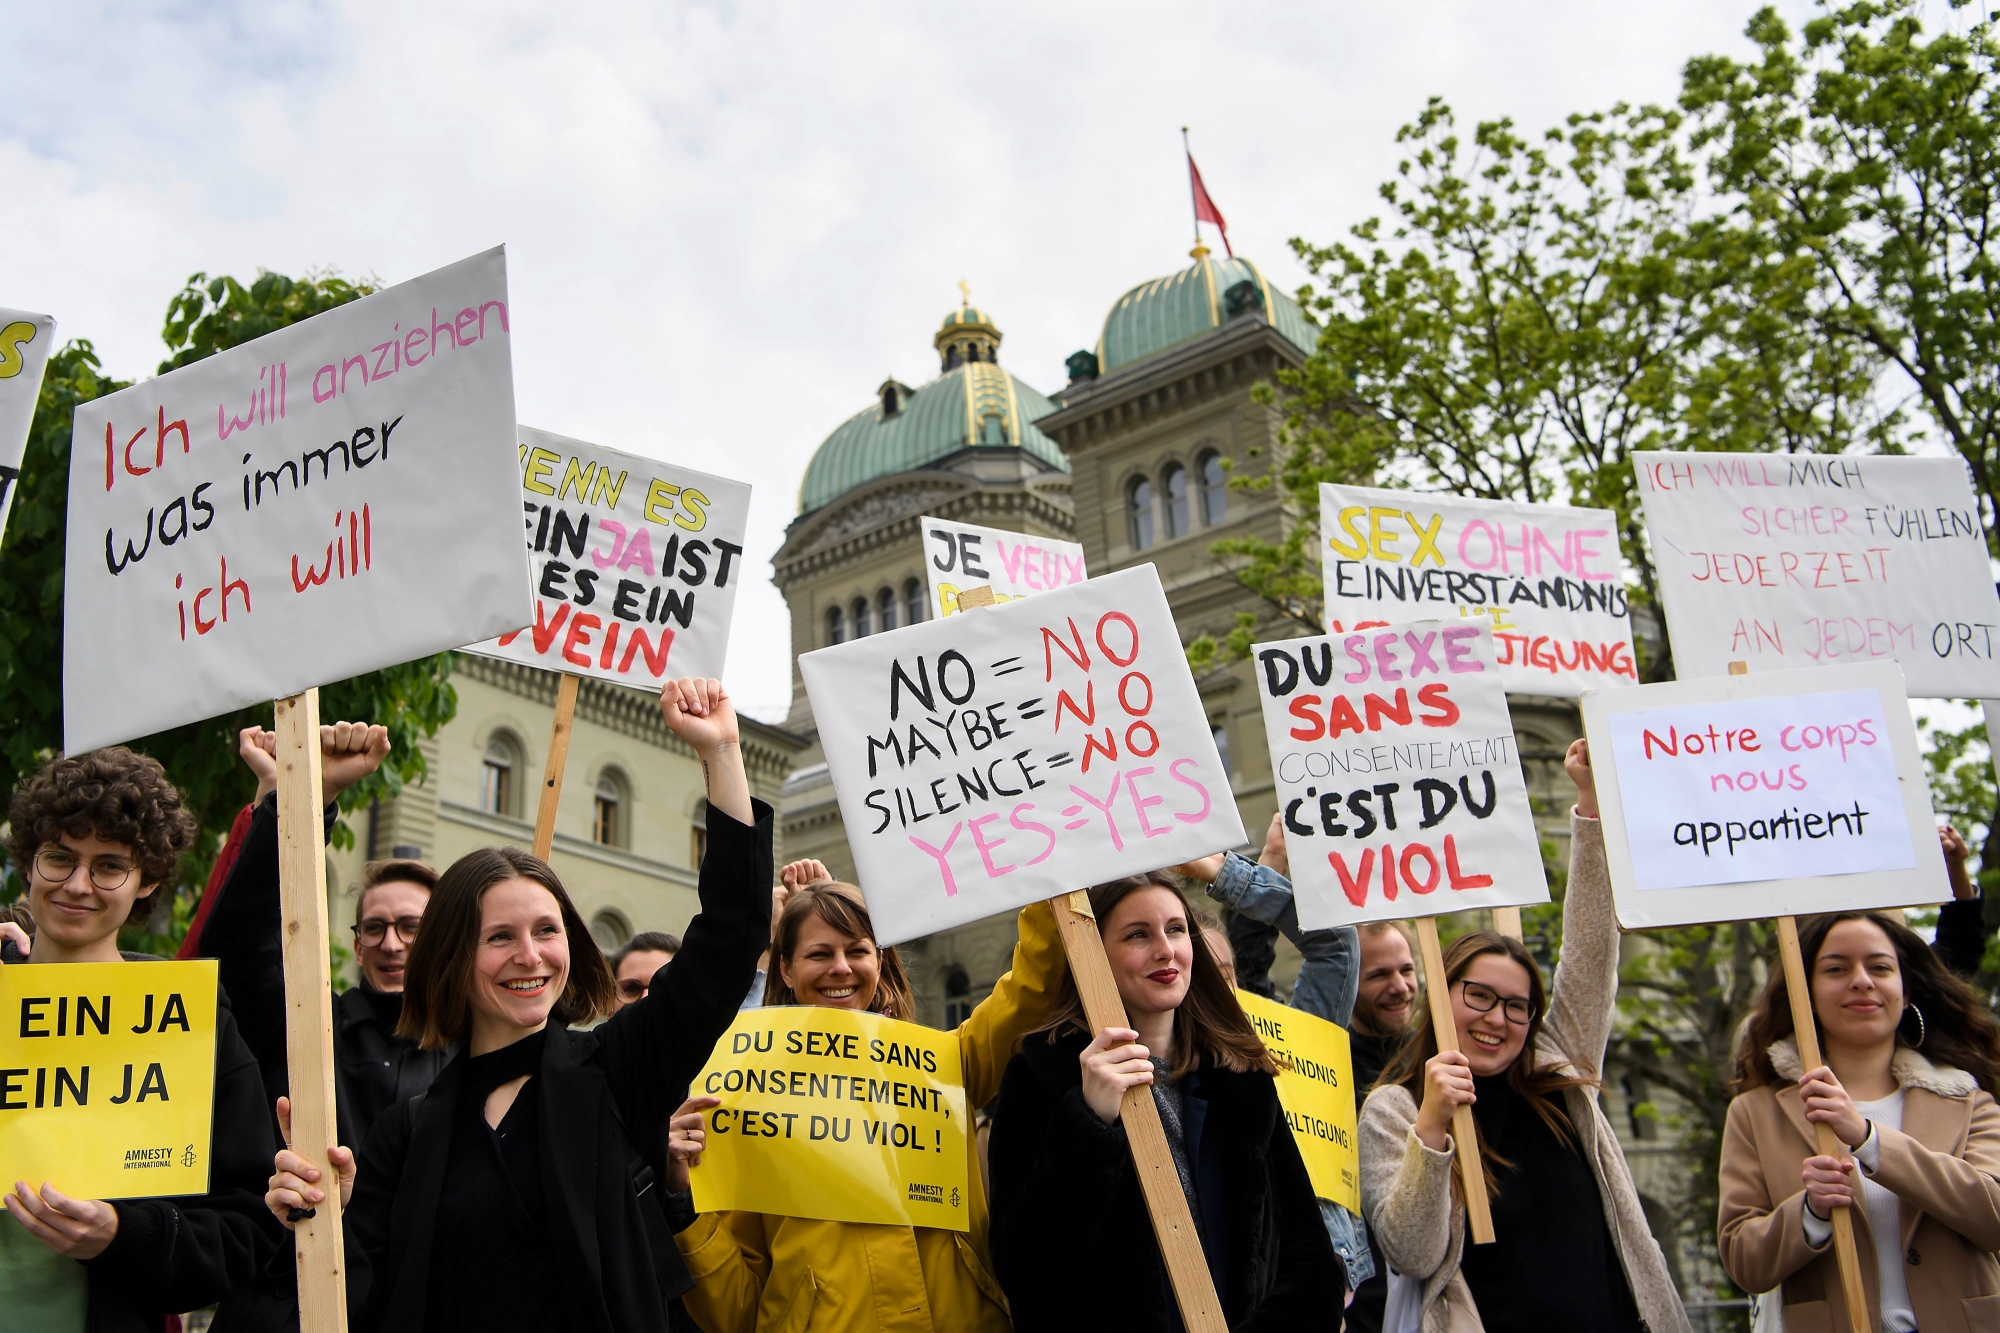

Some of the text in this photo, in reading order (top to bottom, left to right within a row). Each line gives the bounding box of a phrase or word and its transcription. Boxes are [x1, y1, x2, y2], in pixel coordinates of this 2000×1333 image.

[105, 405, 190, 491] Ich
[217, 361, 287, 440] will
[312, 299, 509, 404] anziehen
[105, 481, 215, 575] was
[243, 413, 404, 511] immer
[518, 443, 711, 532] ENN ES
[1645, 459, 1865, 492] ICH WILL MICH
[1329, 505, 1615, 581] SEX OHNE
[1741, 505, 1980, 542] SICHER FÜHLEN,
[175, 503, 371, 641] ich will
[591, 518, 656, 577] JA
[662, 532, 743, 588] IST
[930, 530, 1085, 590] JE VEUX
[1690, 548, 1892, 589] JEDERZEIT
[539, 560, 695, 629] ES EIN
[1336, 559, 1628, 618] EINVERSTÄNDNIS
[1259, 626, 1486, 698] DU SEXE
[1732, 617, 1999, 660] AN JEDEM ORT
[890, 648, 977, 722] NO
[1039, 610, 1139, 683] NO
[1288, 682, 1461, 742] SANS
[1279, 735, 1514, 784] CONSENTEMENT
[1643, 718, 1878, 763] Notre corps
[1710, 763, 1808, 793] nous
[1284, 769, 1497, 839] C'EST DU
[1673, 800, 1870, 858] appartient
[1327, 833, 1494, 909] VIOL
[19, 993, 191, 1038] EIN JA
[732, 1030, 937, 1073] DU SEXE SANS
[0, 1062, 170, 1111] EIN JA
[705, 1068, 950, 1119] CONSENTEMENT,
[124, 1147, 173, 1161] AMNESTY
[711, 1108, 799, 1139] C'EST
[809, 1115, 851, 1143] DU
[862, 1120, 926, 1151] VIOL
[123, 1160, 172, 1170] INTERNATIONAL
[908, 1182, 944, 1197] AMNESTY
[908, 1194, 944, 1205] INTERNATIONAL
